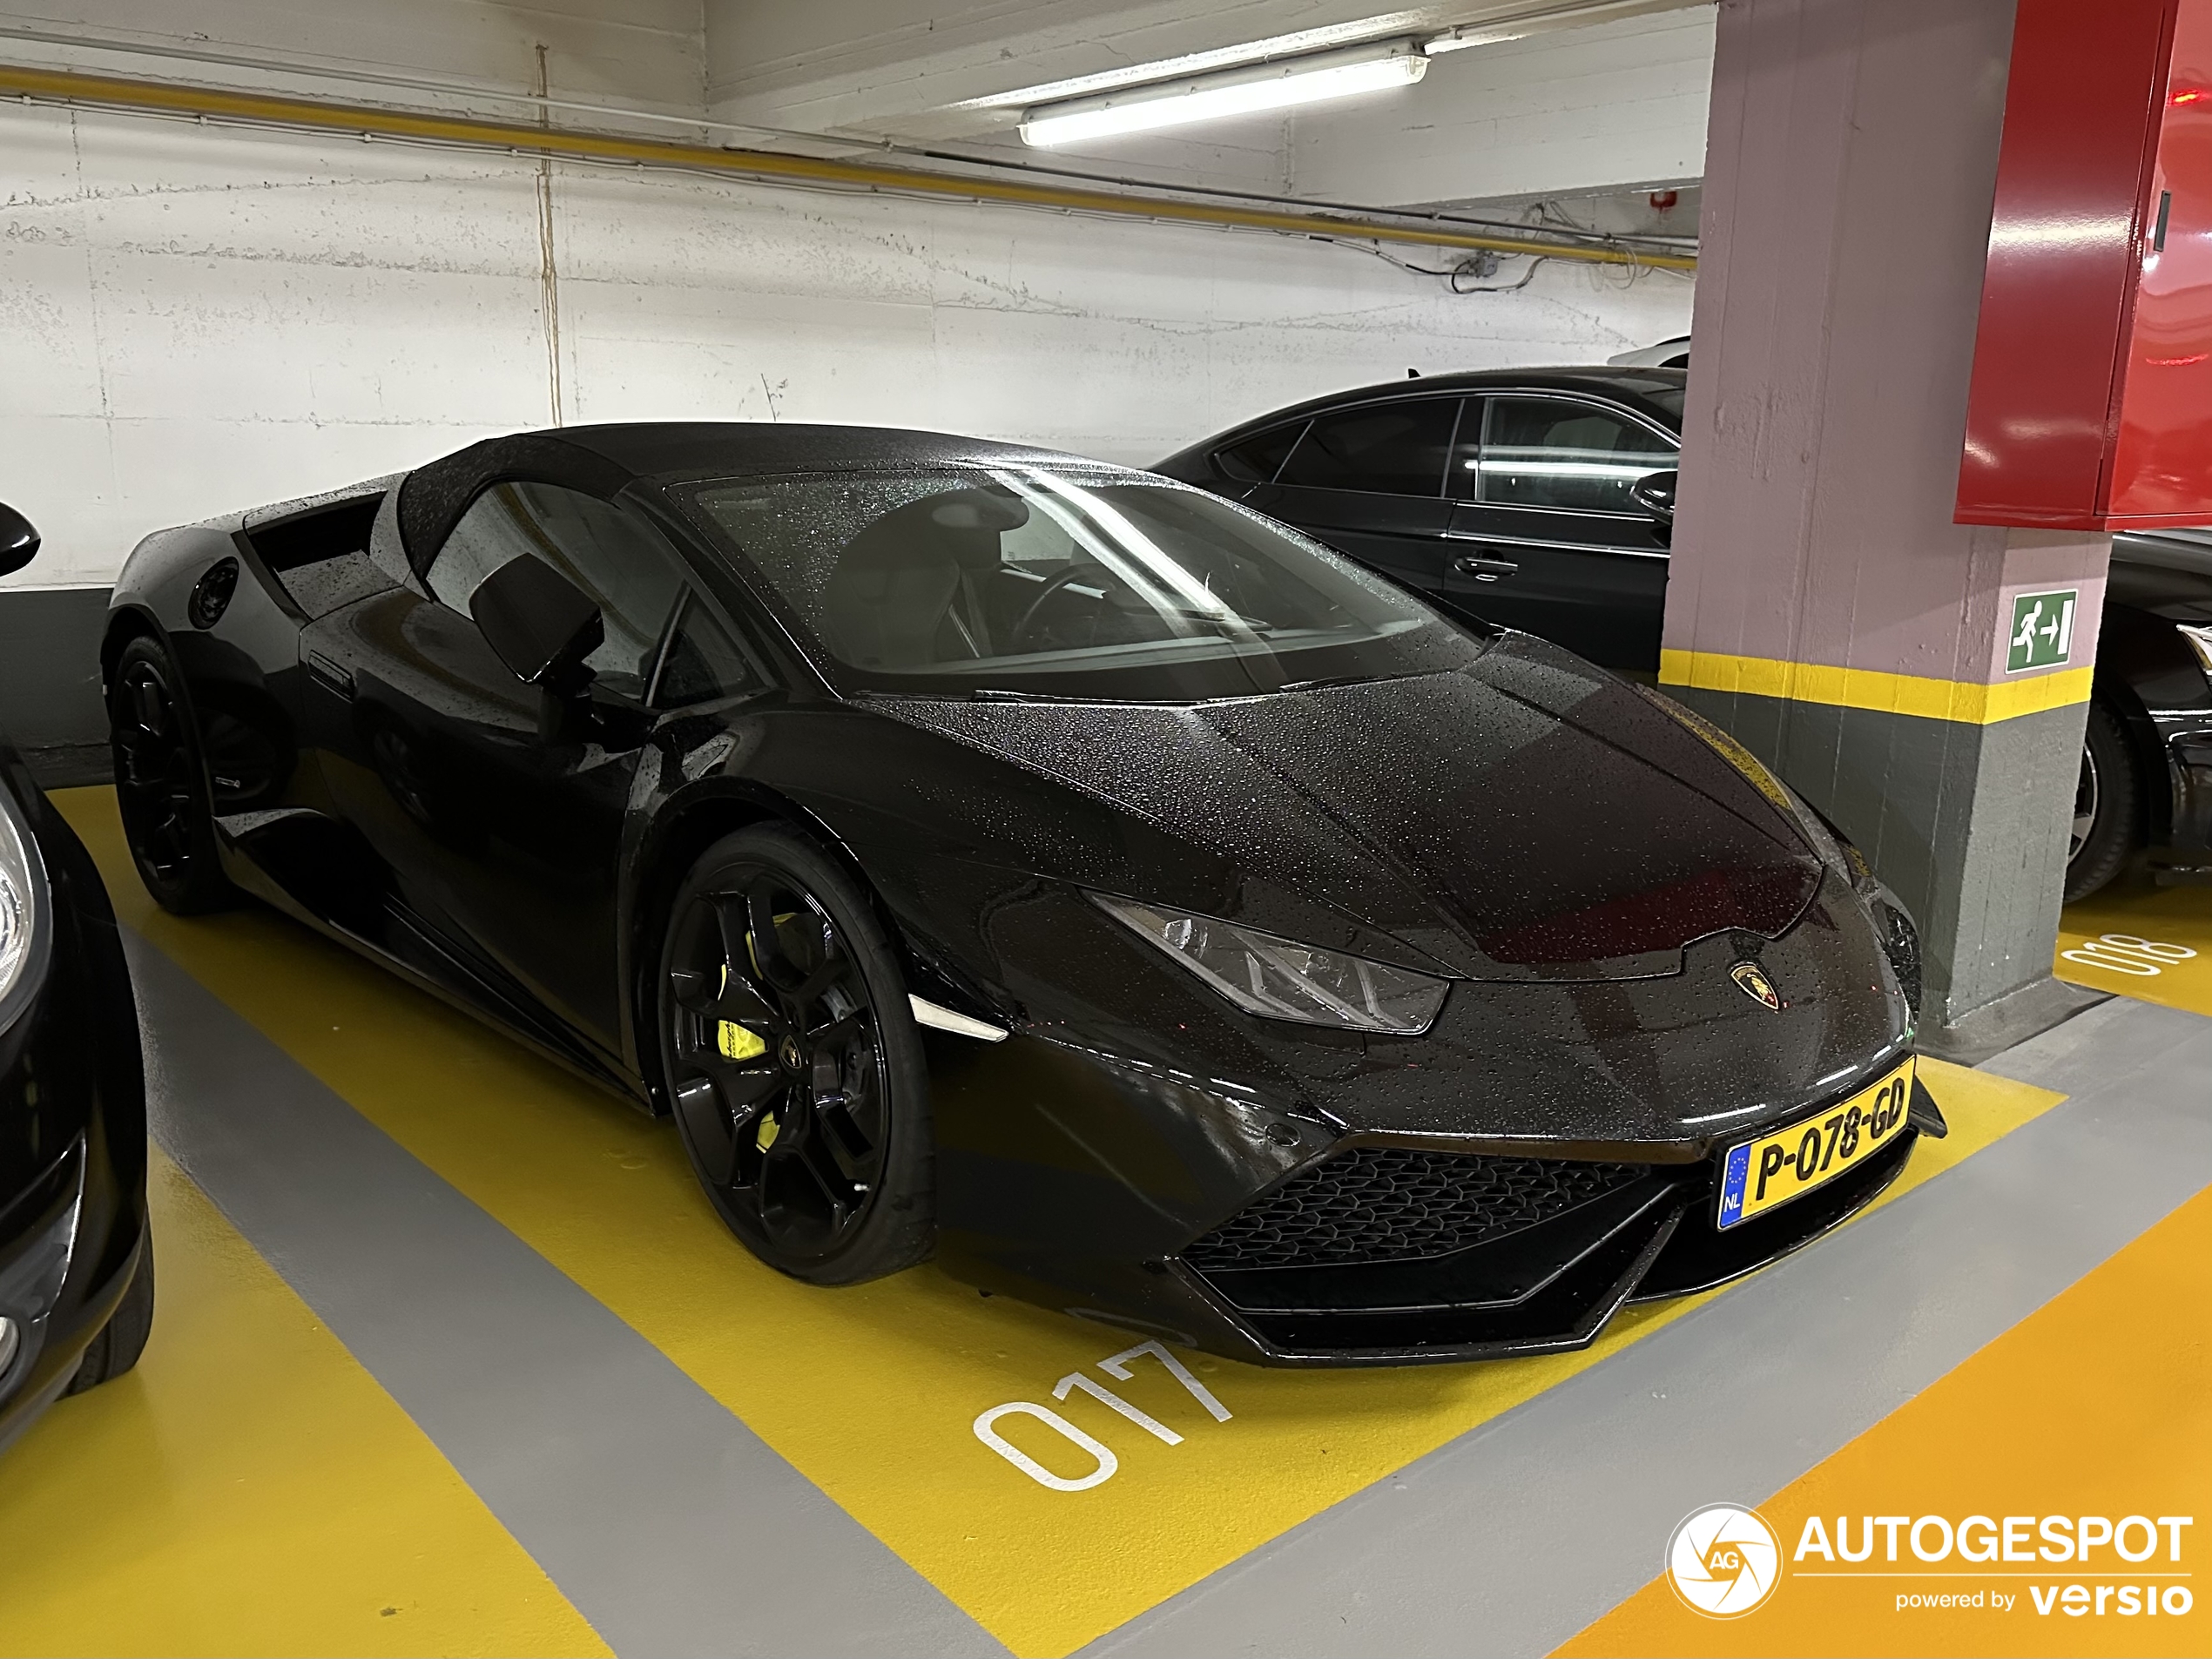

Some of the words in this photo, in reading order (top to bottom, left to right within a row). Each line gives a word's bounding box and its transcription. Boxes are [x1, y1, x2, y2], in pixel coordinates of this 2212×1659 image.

[2060, 934, 2197, 976] 018
[1756, 1077, 1905, 1202] P-078-GD
[1723, 1192, 1741, 1212] NL
[973, 1339, 1233, 1492] 017
